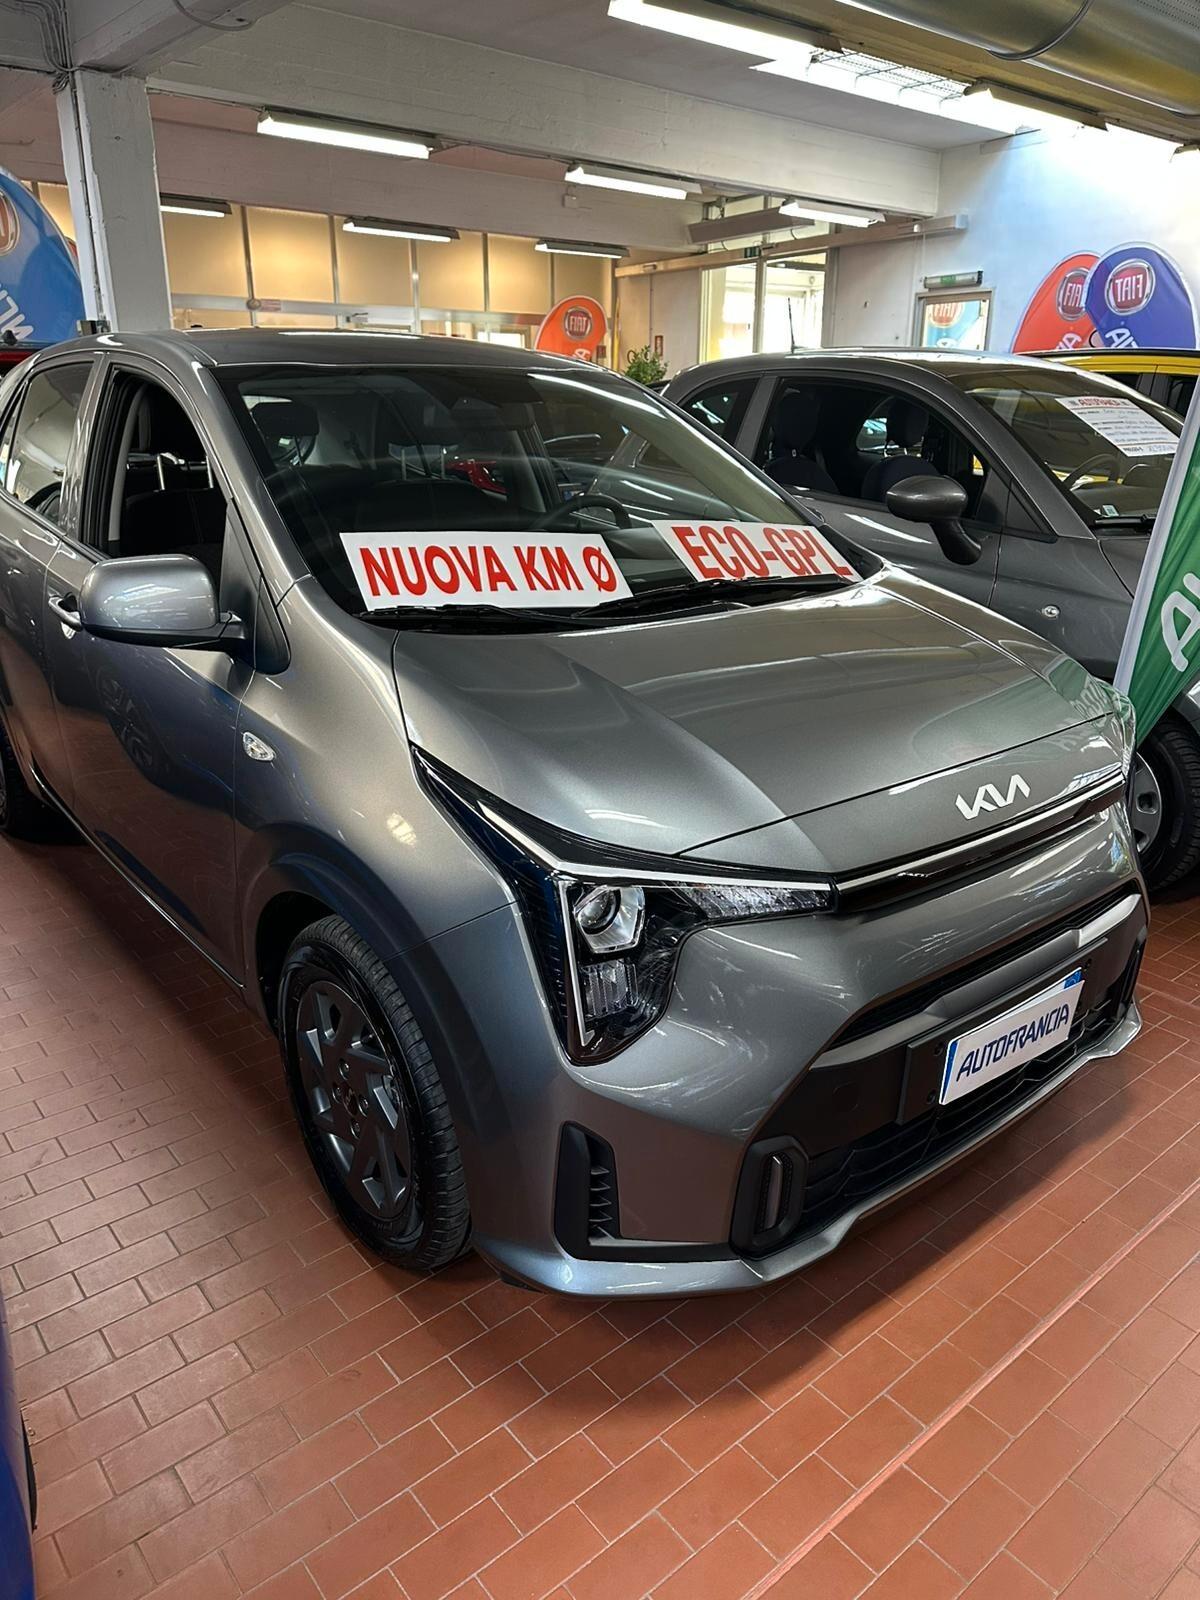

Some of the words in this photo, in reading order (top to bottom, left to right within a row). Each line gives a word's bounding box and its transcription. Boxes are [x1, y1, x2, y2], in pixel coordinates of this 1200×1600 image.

[1064, 283, 1083, 306] FIA
[569, 315, 588, 332] FIAT
[359, 545, 516, 596] NUOVA
[514, 546, 580, 591] KM
[671, 525, 853, 579] ECO-GPL
[956, 1004, 1070, 1082] AUTOFRANCIA
